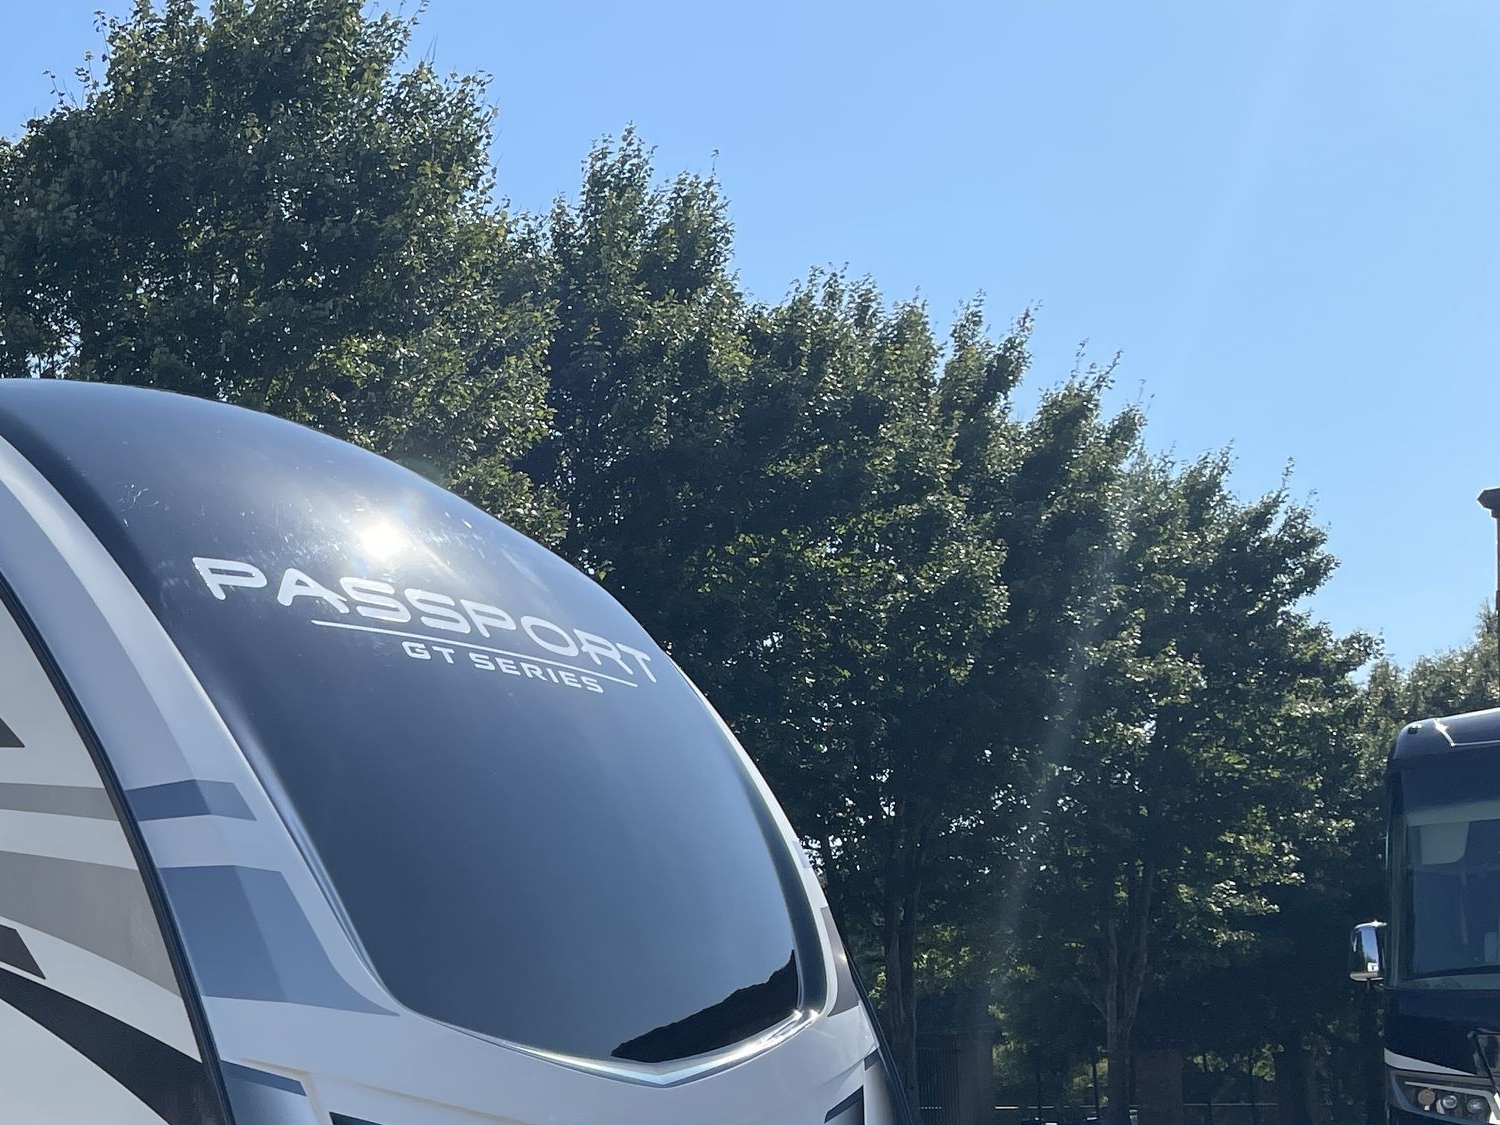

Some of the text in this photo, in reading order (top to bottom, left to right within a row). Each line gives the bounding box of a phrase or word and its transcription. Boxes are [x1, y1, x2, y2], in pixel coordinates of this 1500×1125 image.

[192, 556, 657, 683] PASSPORT
[401, 641, 604, 693] GT SERIES
